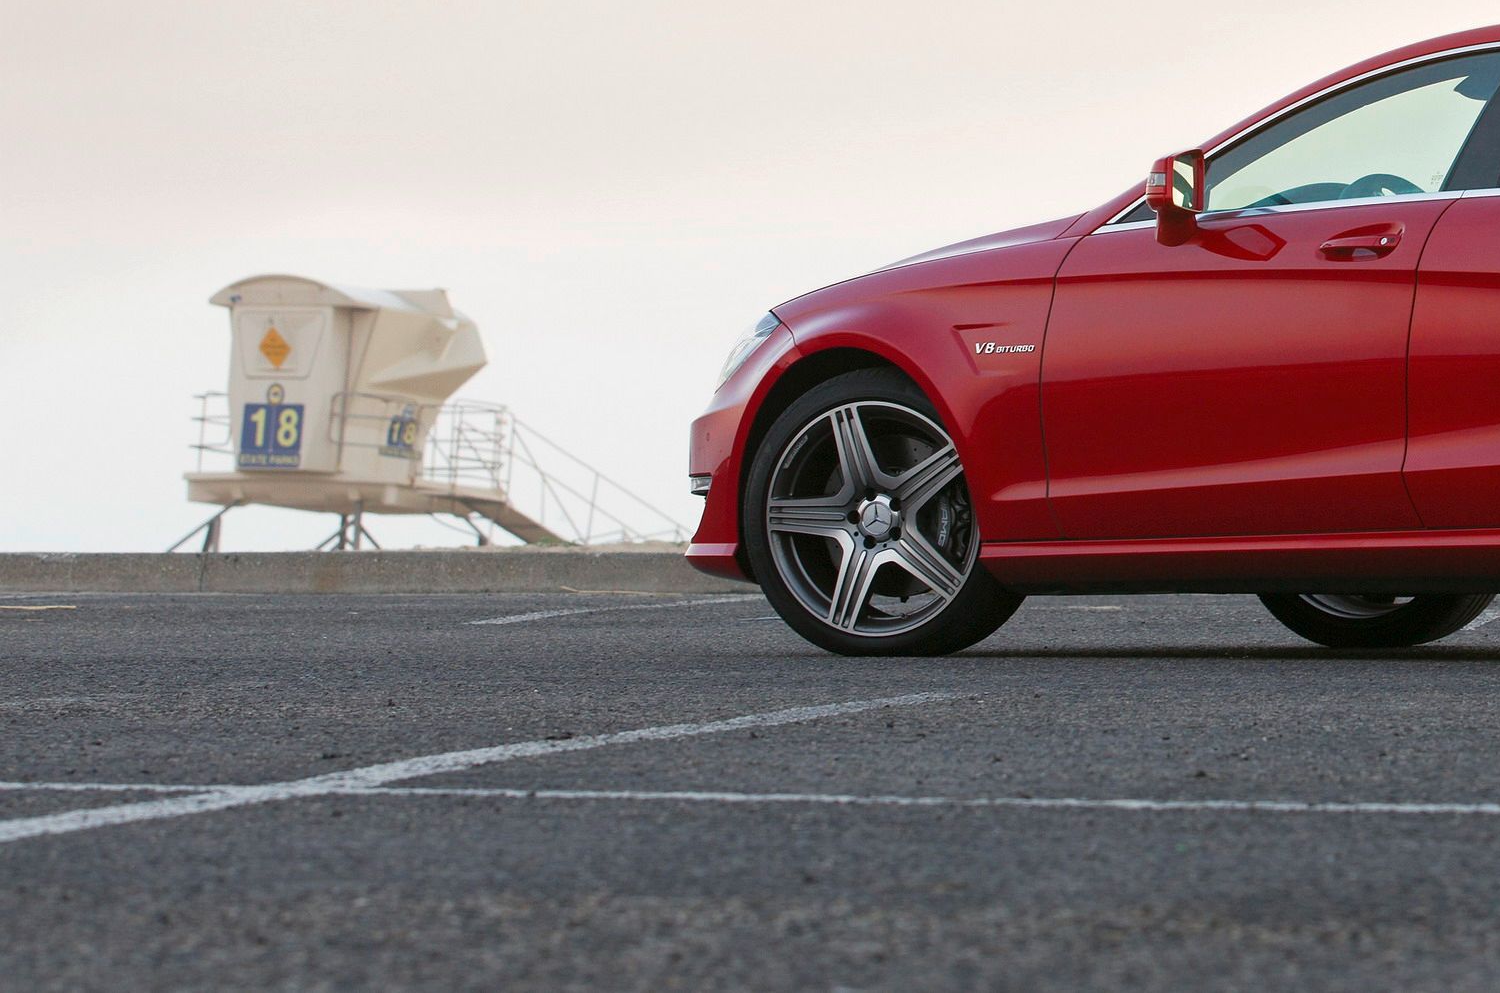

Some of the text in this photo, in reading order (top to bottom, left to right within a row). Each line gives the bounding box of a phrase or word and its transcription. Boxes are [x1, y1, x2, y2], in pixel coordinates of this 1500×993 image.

[975, 342, 1035, 354] V8 BITURBO
[250, 408, 299, 447] 18
[391, 421, 417, 446] 18
[938, 509, 949, 547] AMG
